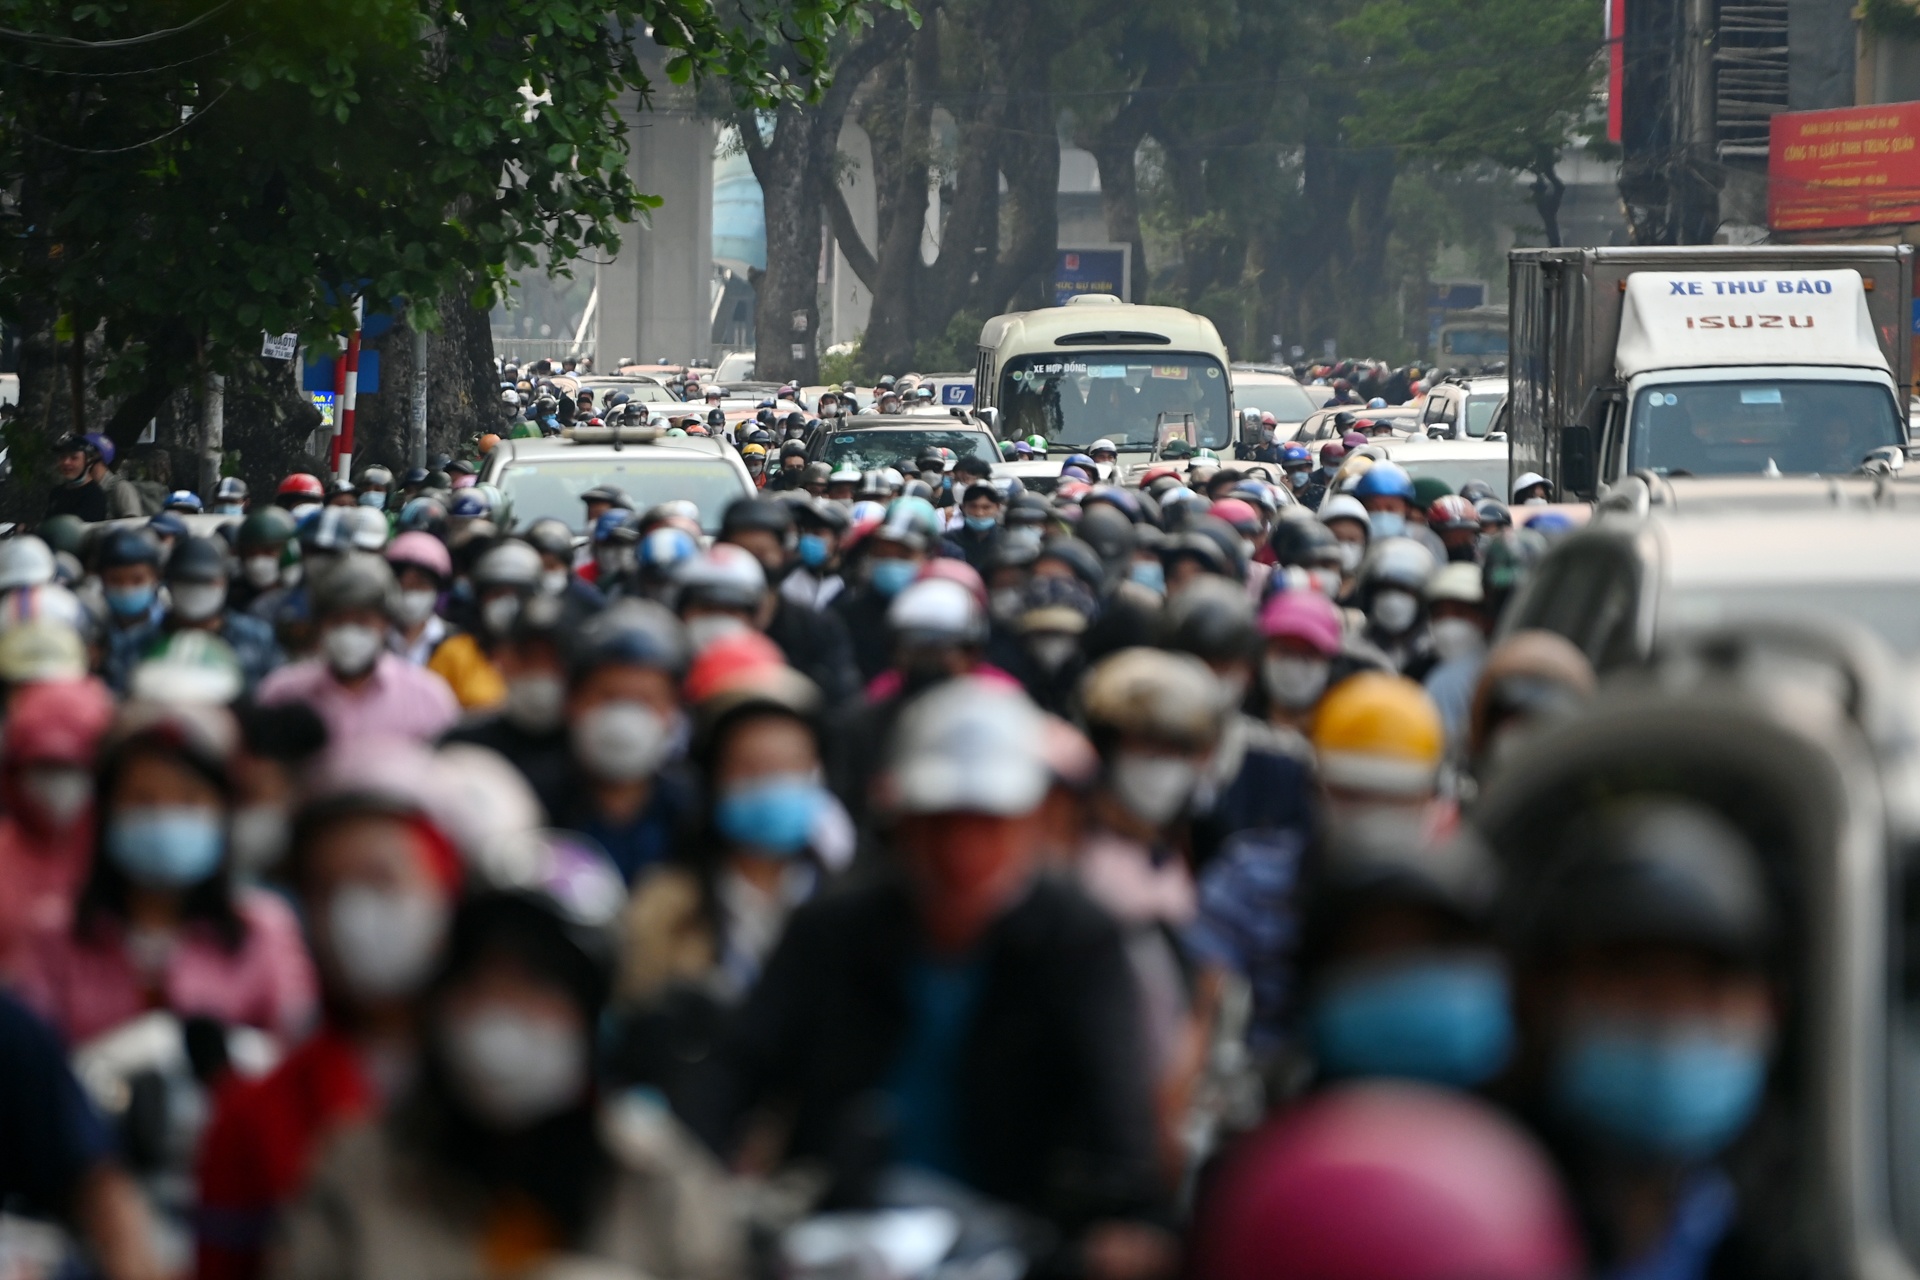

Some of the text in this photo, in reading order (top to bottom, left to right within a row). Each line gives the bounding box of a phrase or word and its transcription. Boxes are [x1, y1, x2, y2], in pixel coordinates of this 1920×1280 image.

[1669, 281, 1704, 295] XE
[1712, 279, 1768, 295] THƯ
[1686, 314, 1815, 329] ISUZU
[1033, 364, 1044, 373] XE
[1045, 363, 1063, 374] HỢP
[950, 386, 967, 403] G7
